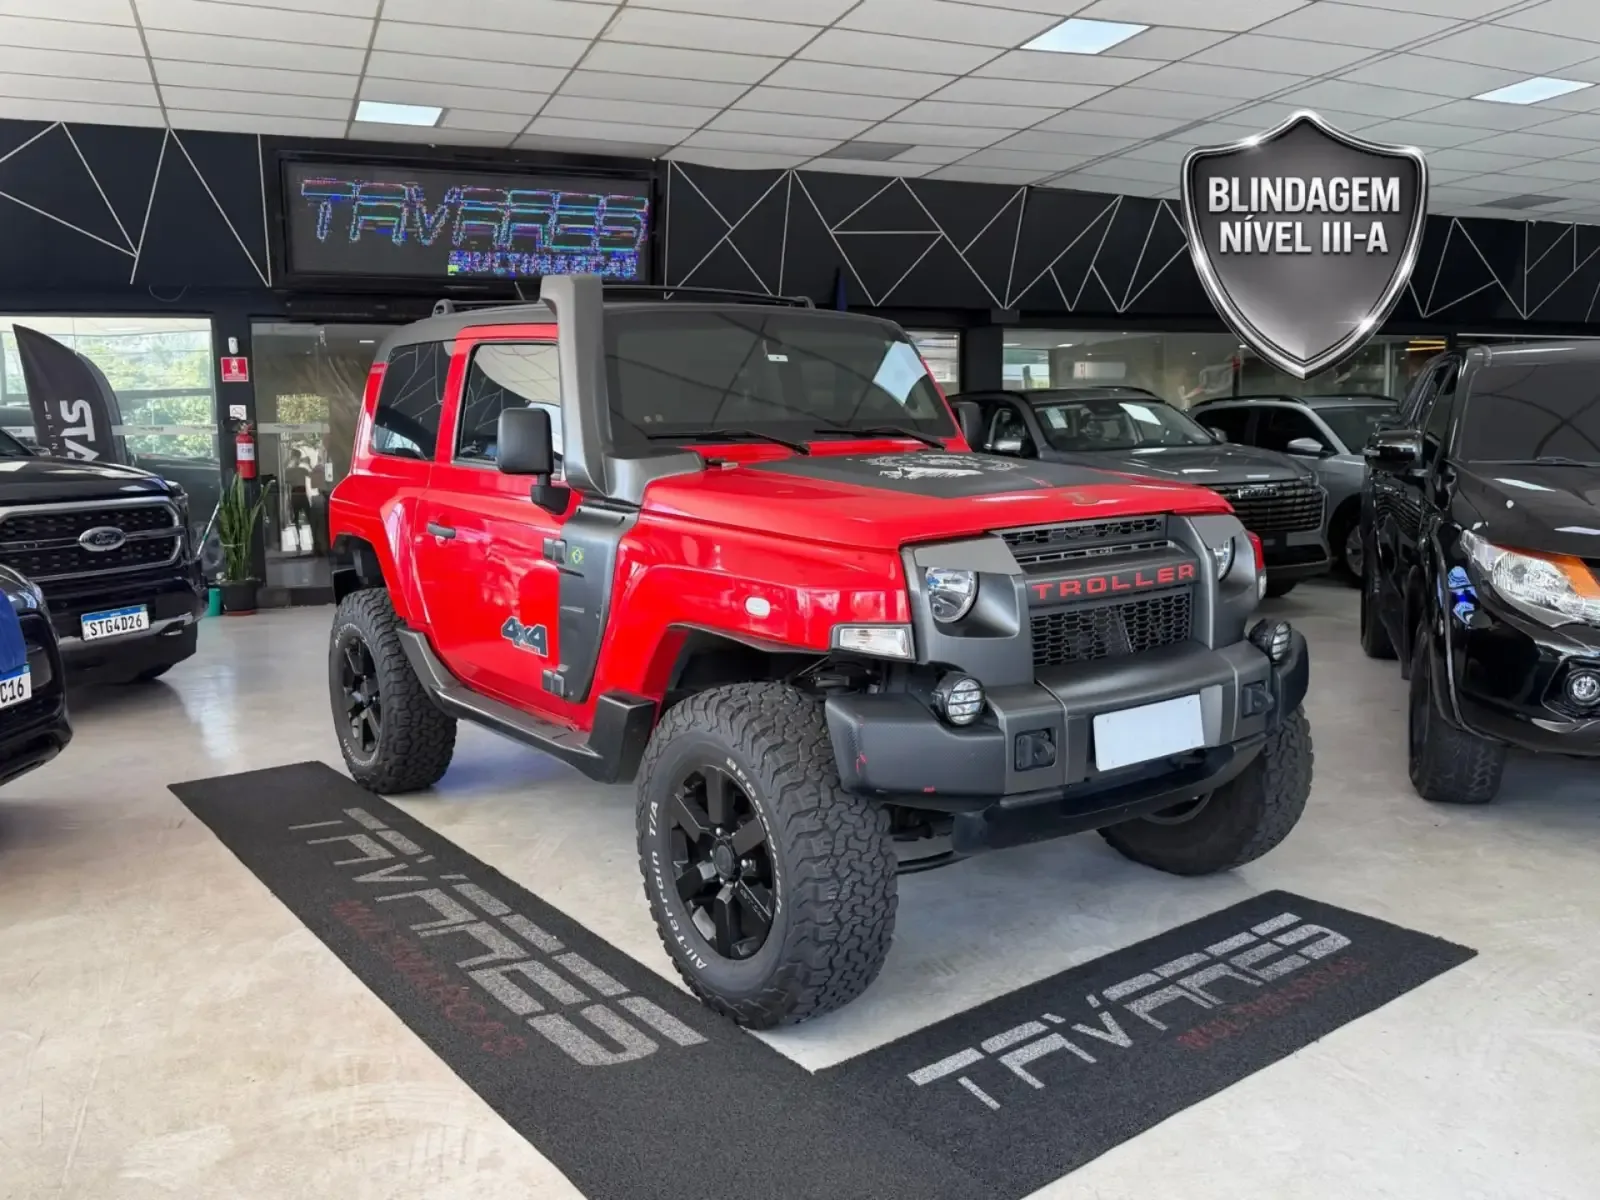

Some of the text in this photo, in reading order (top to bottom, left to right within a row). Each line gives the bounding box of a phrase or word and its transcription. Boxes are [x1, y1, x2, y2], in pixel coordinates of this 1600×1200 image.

[301, 178, 650, 252] TAVARES
[89, 614, 143, 637] STG4D26
[1031, 563, 1196, 600] TROLLER
[288, 807, 709, 1067] TAVARES
[648, 800, 709, 971] All-Terrain T/A
[906, 911, 1352, 1111] TAVARES
